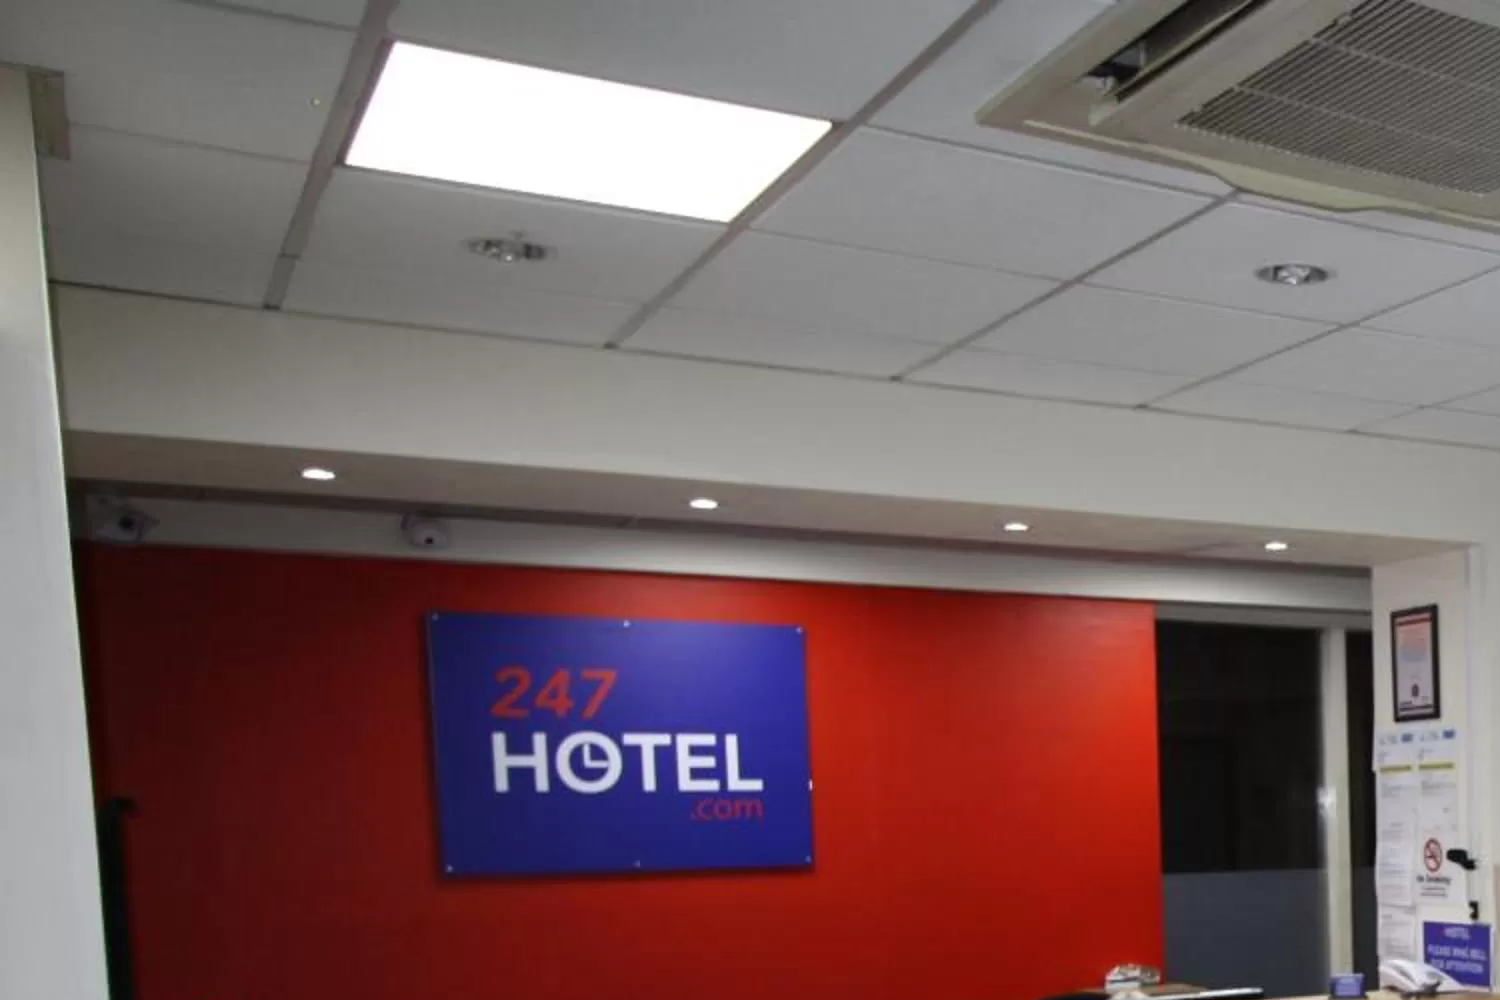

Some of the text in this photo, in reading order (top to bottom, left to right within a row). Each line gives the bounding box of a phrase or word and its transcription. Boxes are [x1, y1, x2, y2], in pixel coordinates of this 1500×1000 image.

[490, 665, 617, 719] 247
[492, 731, 763, 794] HOTEL
[690, 799, 764, 822] .com
